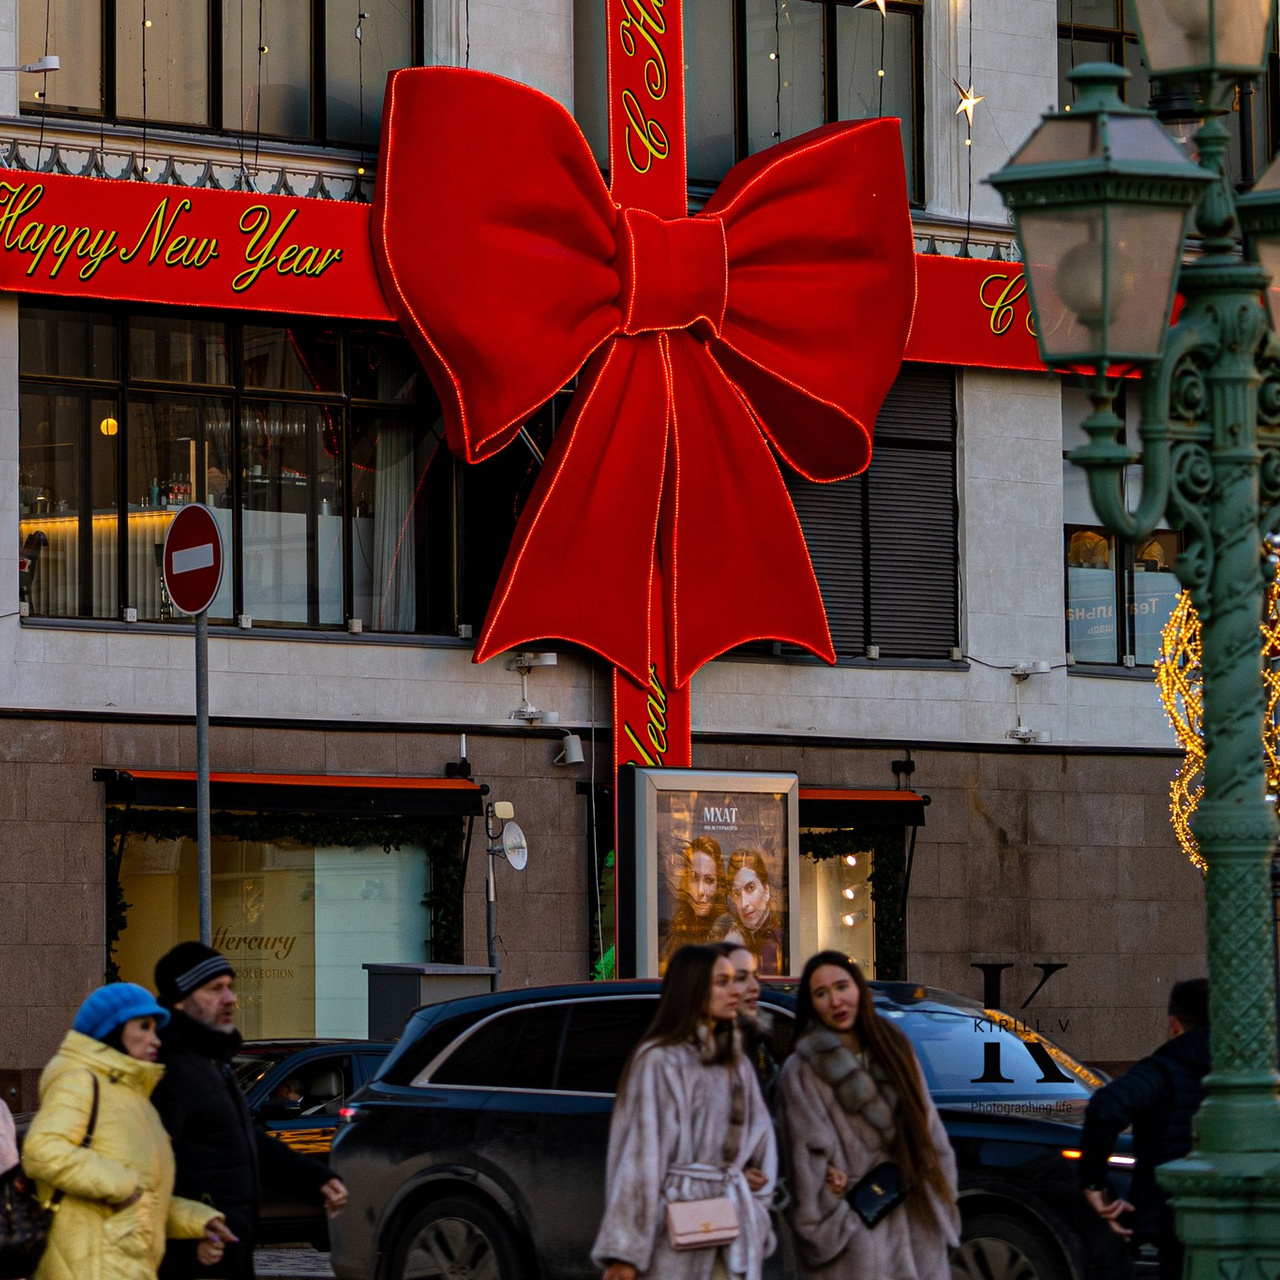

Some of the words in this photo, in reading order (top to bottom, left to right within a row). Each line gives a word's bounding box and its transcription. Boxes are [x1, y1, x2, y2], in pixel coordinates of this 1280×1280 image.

[623, 90, 669, 175] С
[119, 198, 219, 268] New
[231, 204, 343, 292] Year
